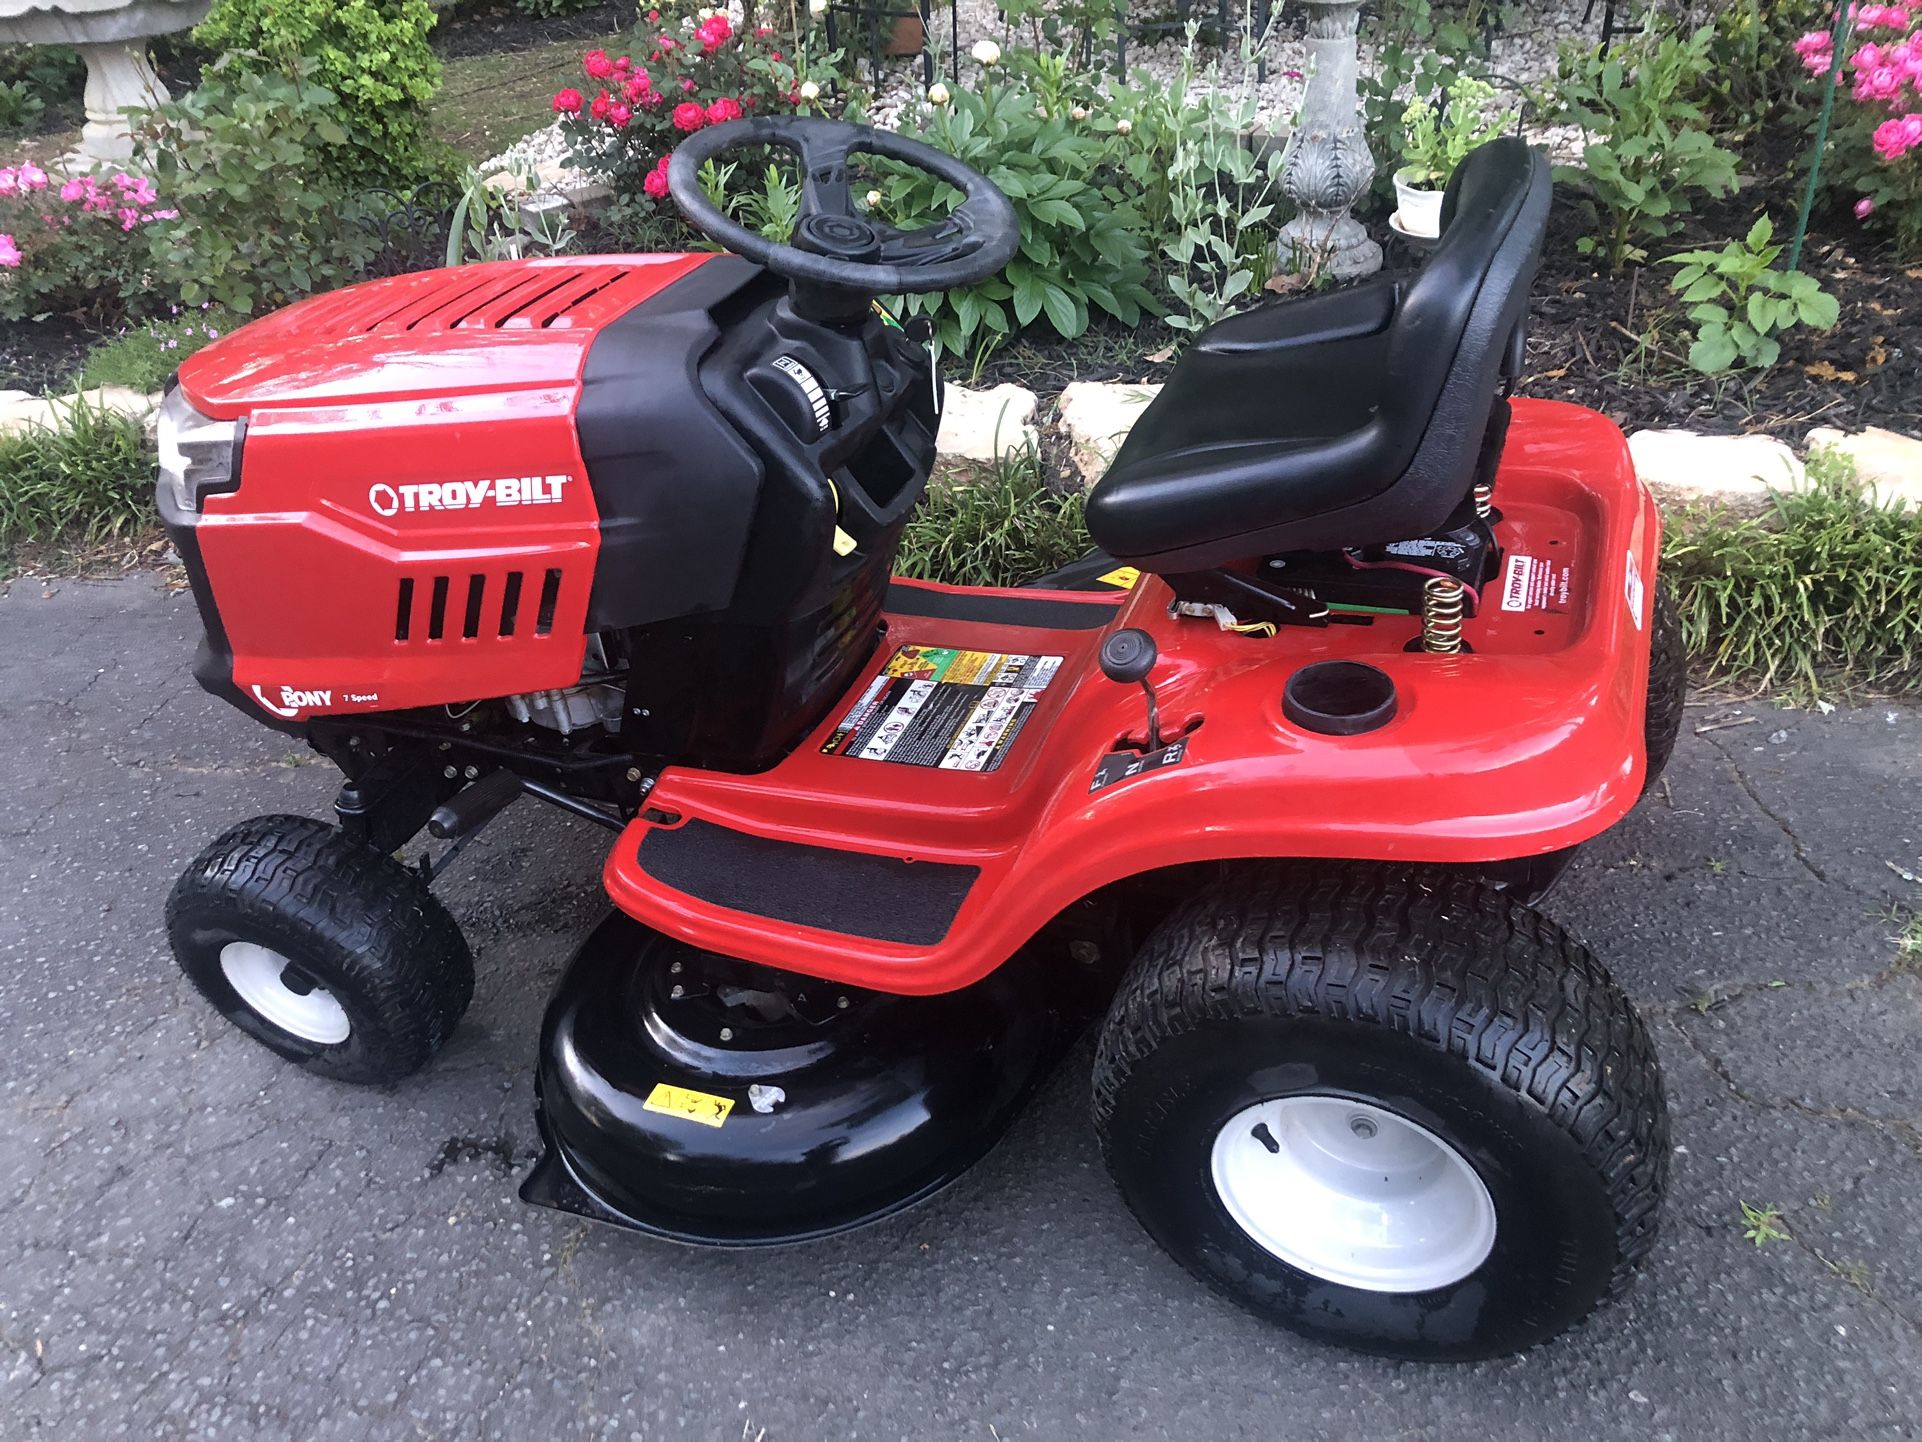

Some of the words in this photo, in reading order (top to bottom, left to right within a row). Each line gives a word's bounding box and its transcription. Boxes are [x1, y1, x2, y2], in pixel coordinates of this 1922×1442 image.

[399, 475, 567, 512] TROY-BILT
[1509, 558, 1526, 599] TROY-BILT
[1558, 567, 1570, 604] troybilt.com
[280, 686, 331, 707] PONY
[351, 693, 378, 703] Speed
[855, 700, 880, 725] DANGER
[998, 718, 1017, 744] WARNING
